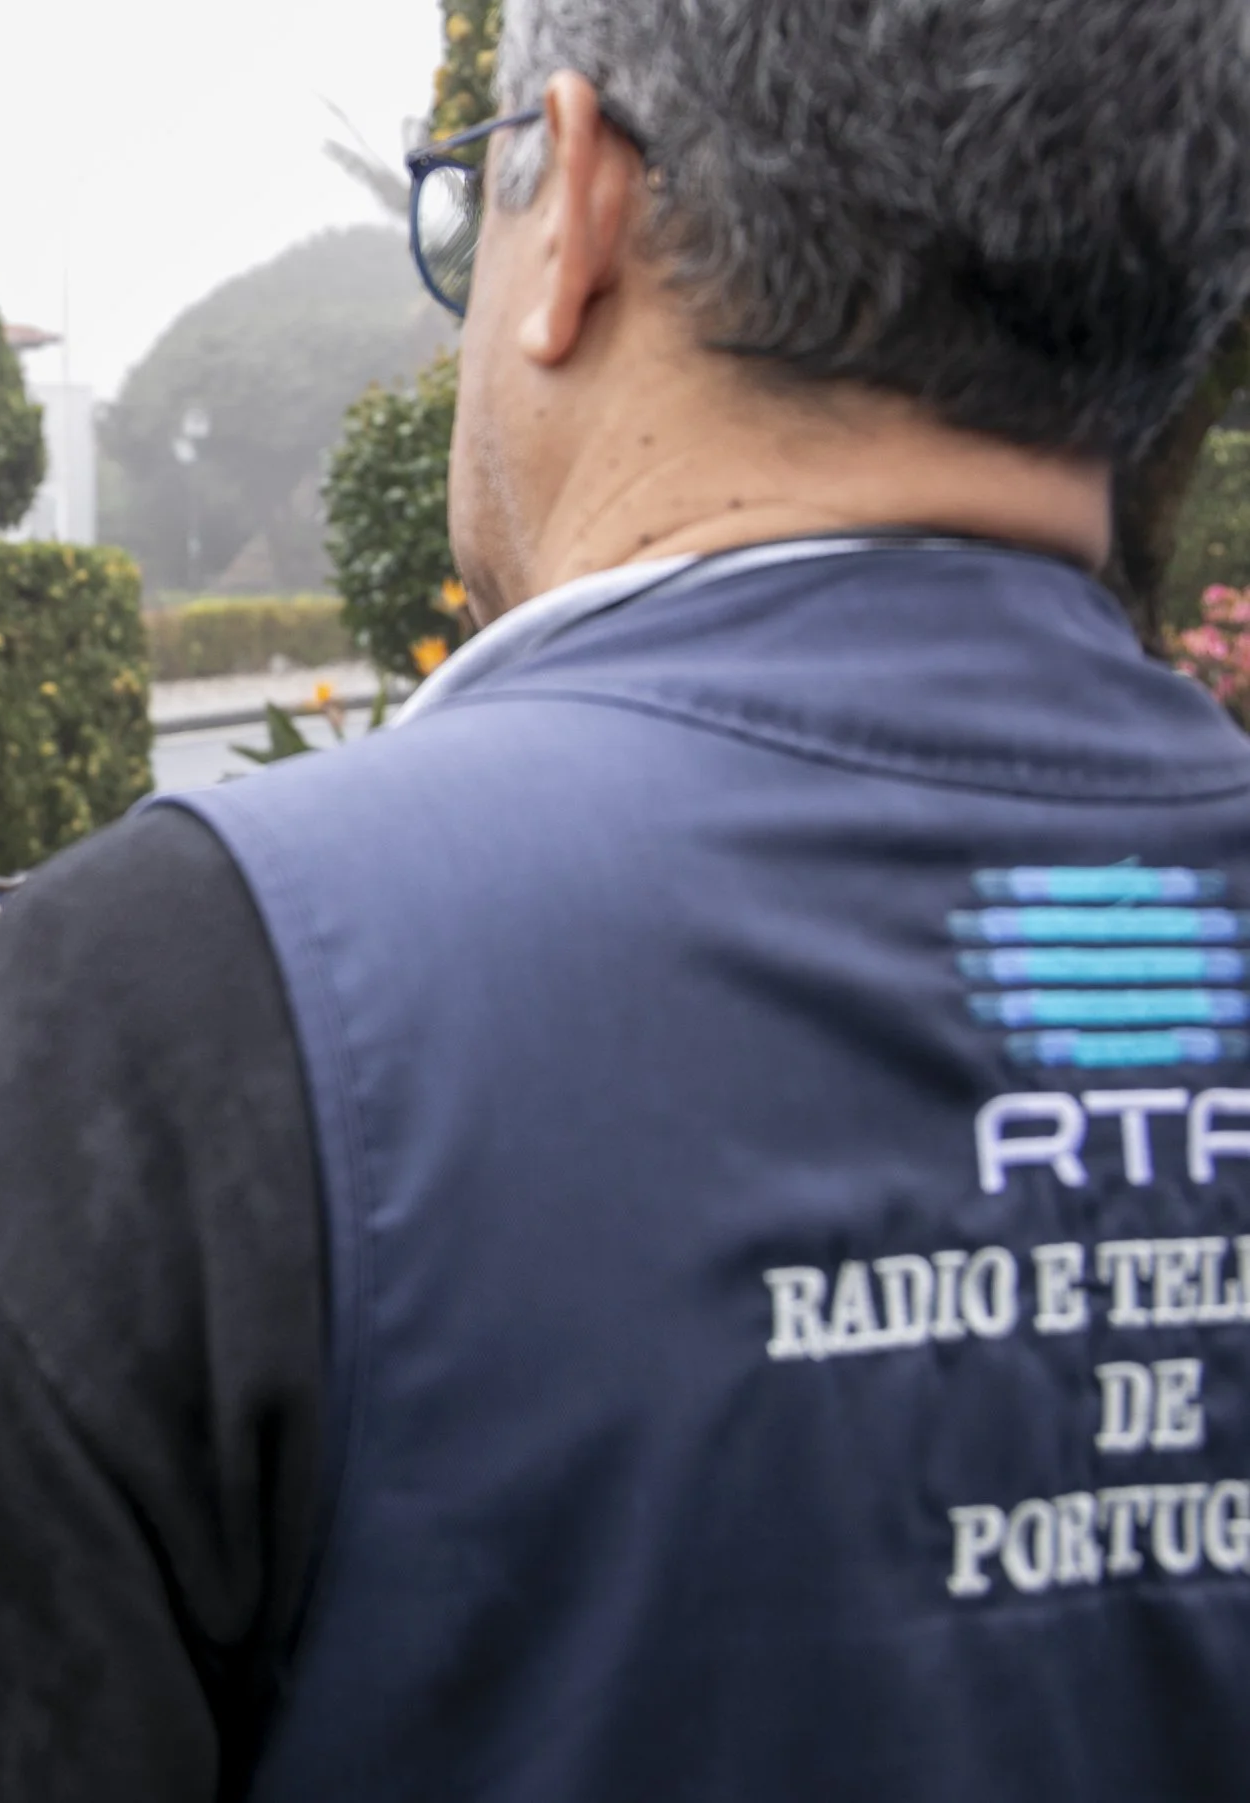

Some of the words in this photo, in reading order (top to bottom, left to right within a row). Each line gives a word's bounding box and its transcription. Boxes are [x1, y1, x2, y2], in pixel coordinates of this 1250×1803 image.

[764, 1246, 1018, 1361] RADIO
[1032, 1242, 1087, 1335] E
[1094, 1357, 1204, 1453] DE
[948, 1480, 1250, 1596] PORTUG
